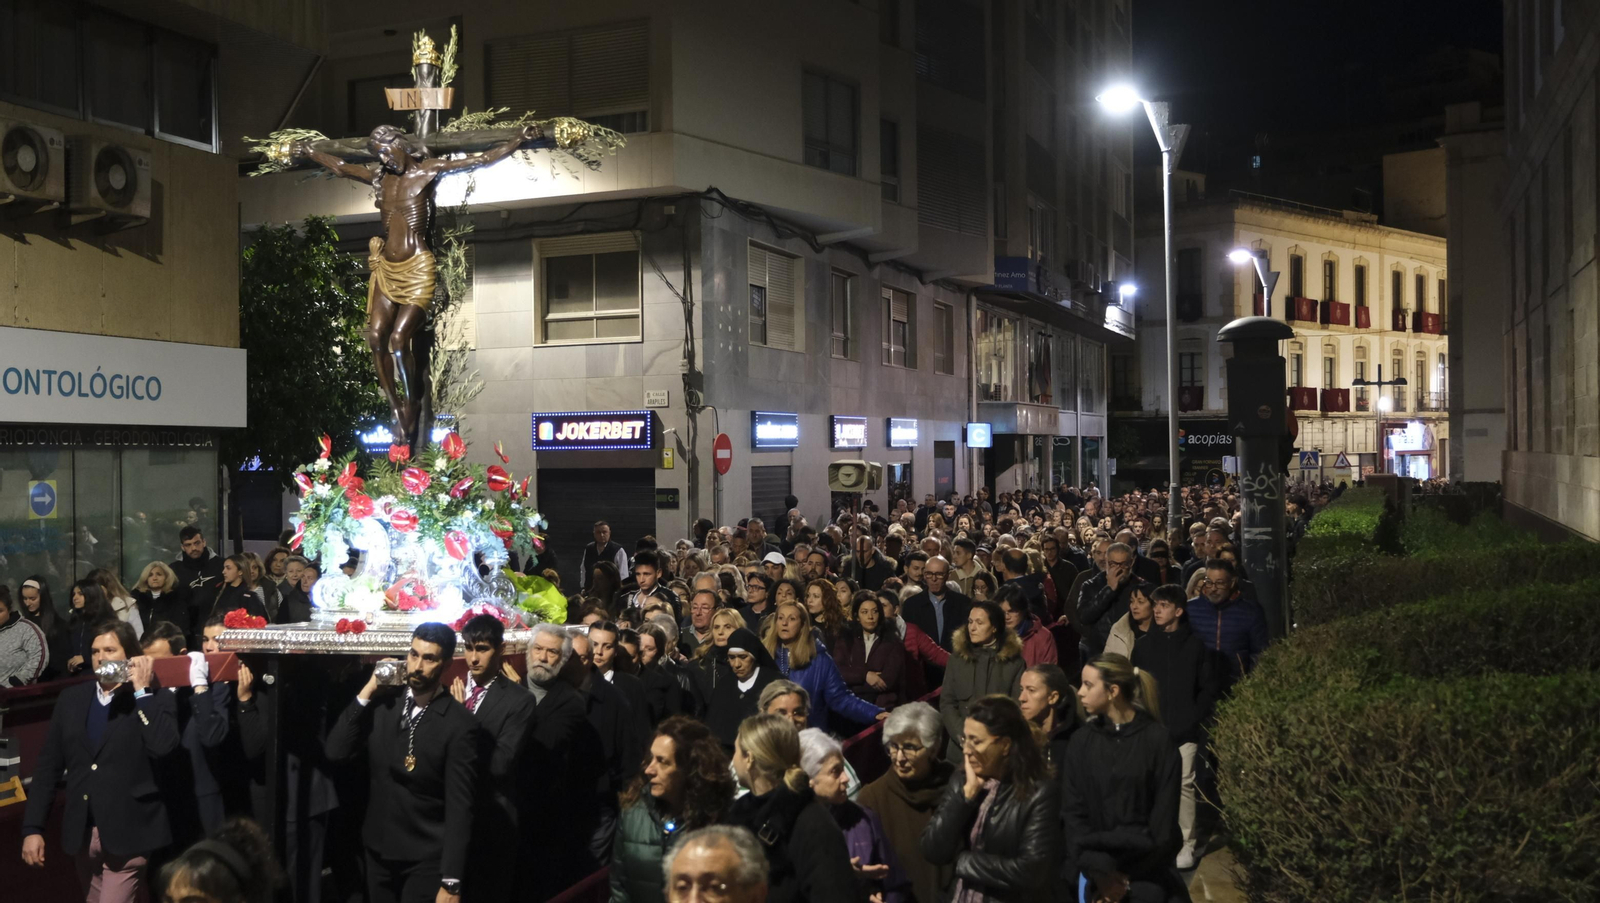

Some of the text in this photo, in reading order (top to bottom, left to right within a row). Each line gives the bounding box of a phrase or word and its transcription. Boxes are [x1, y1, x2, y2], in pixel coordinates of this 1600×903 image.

[399, 90, 439, 108] INRI
[2, 366, 162, 401] ONTOLÓGICO
[556, 421, 645, 440] JOKERBET
[1187, 432, 1233, 447] acopias
